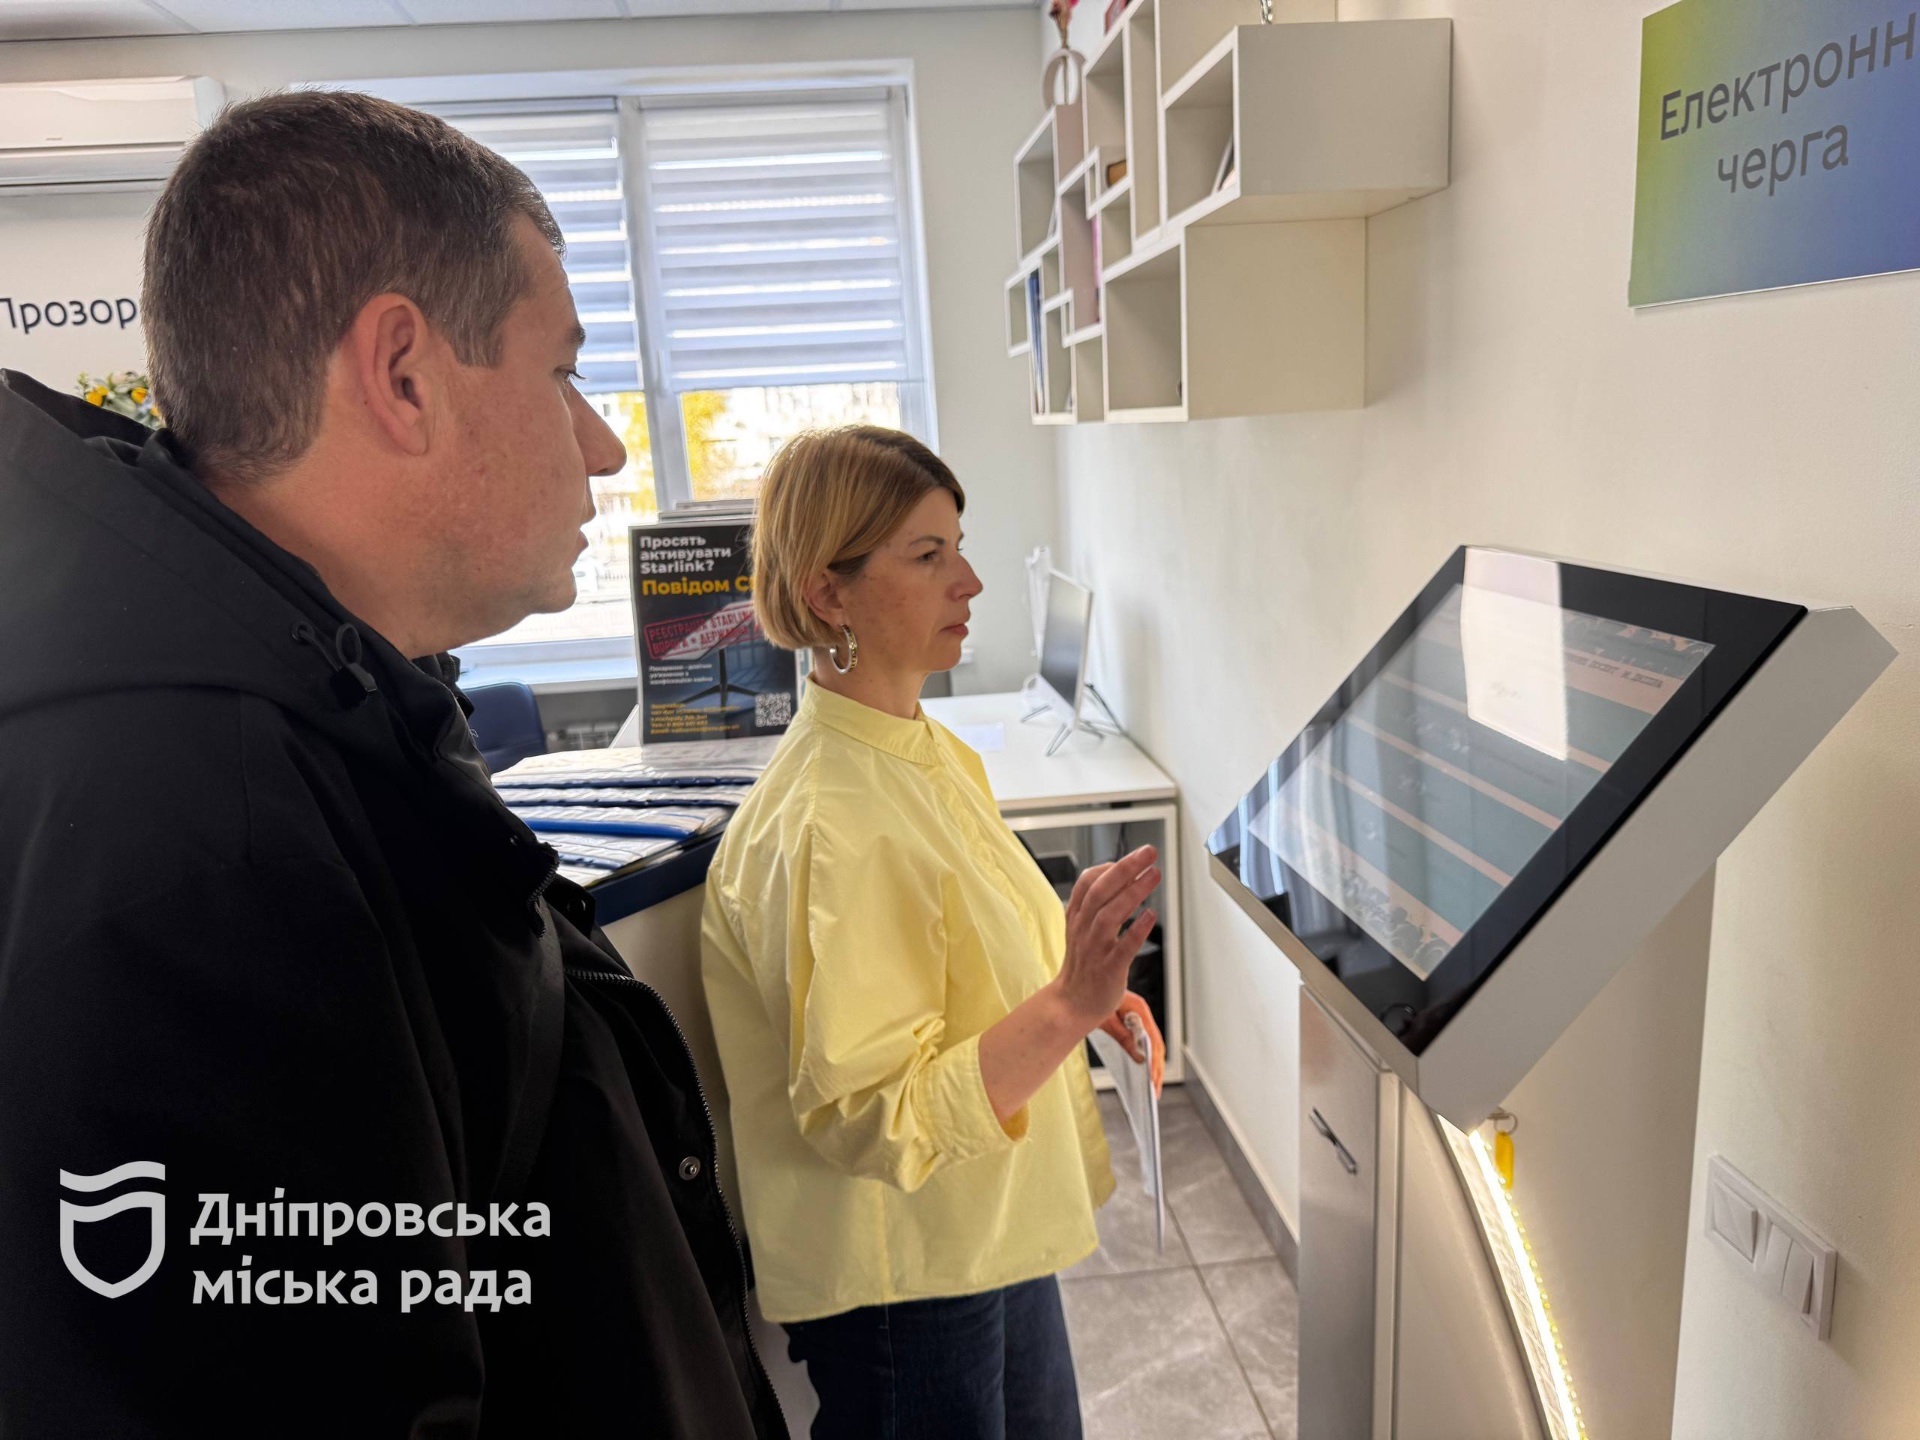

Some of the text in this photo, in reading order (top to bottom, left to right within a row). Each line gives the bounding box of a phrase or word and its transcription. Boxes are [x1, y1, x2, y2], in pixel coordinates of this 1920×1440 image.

[1660, 12, 1917, 141] Електронн
[1717, 124, 1850, 197] черга
[640, 535, 707, 549] Просять
[640, 547, 731, 561] активувати
[640, 559, 715, 574] Starlink?
[642, 576, 730, 596] Повідом
